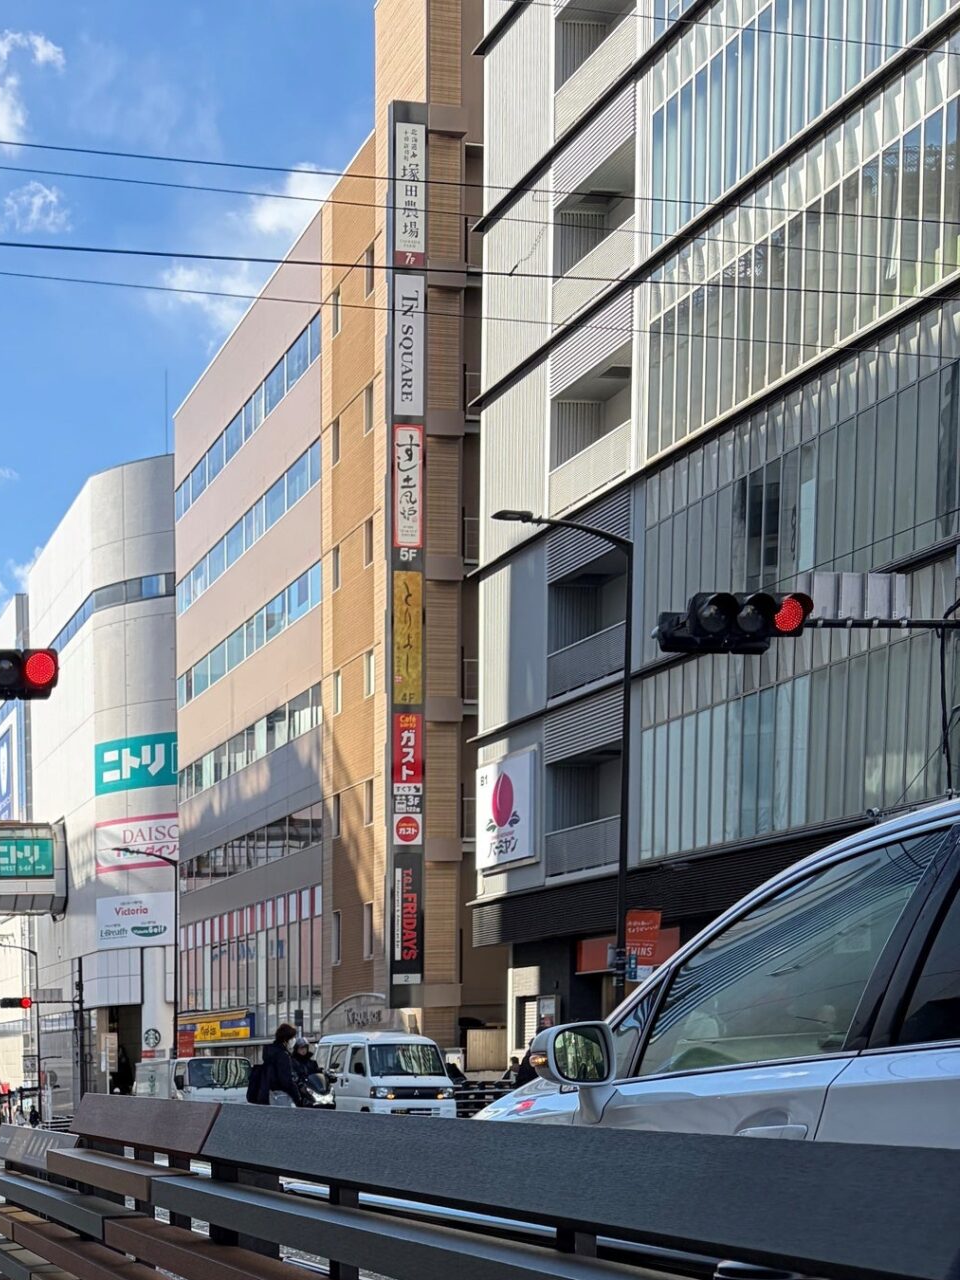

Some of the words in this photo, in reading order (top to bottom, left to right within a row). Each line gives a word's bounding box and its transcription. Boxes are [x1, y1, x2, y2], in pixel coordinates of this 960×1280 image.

[400, 163, 419, 239] 塚田農場
[405, 252, 416, 265] 7F
[399, 324, 414, 402] SQUARE
[400, 547, 417, 561] 5F
[403, 581, 413, 678] とりよし
[400, 692, 415, 703] 4F
[400, 729, 416, 781] ガスト
[102, 743, 165, 783] ニトリ
[407, 795, 420, 806] 3F
[114, 905, 148, 917] Victoria
[626, 946, 653, 957] TWINS
